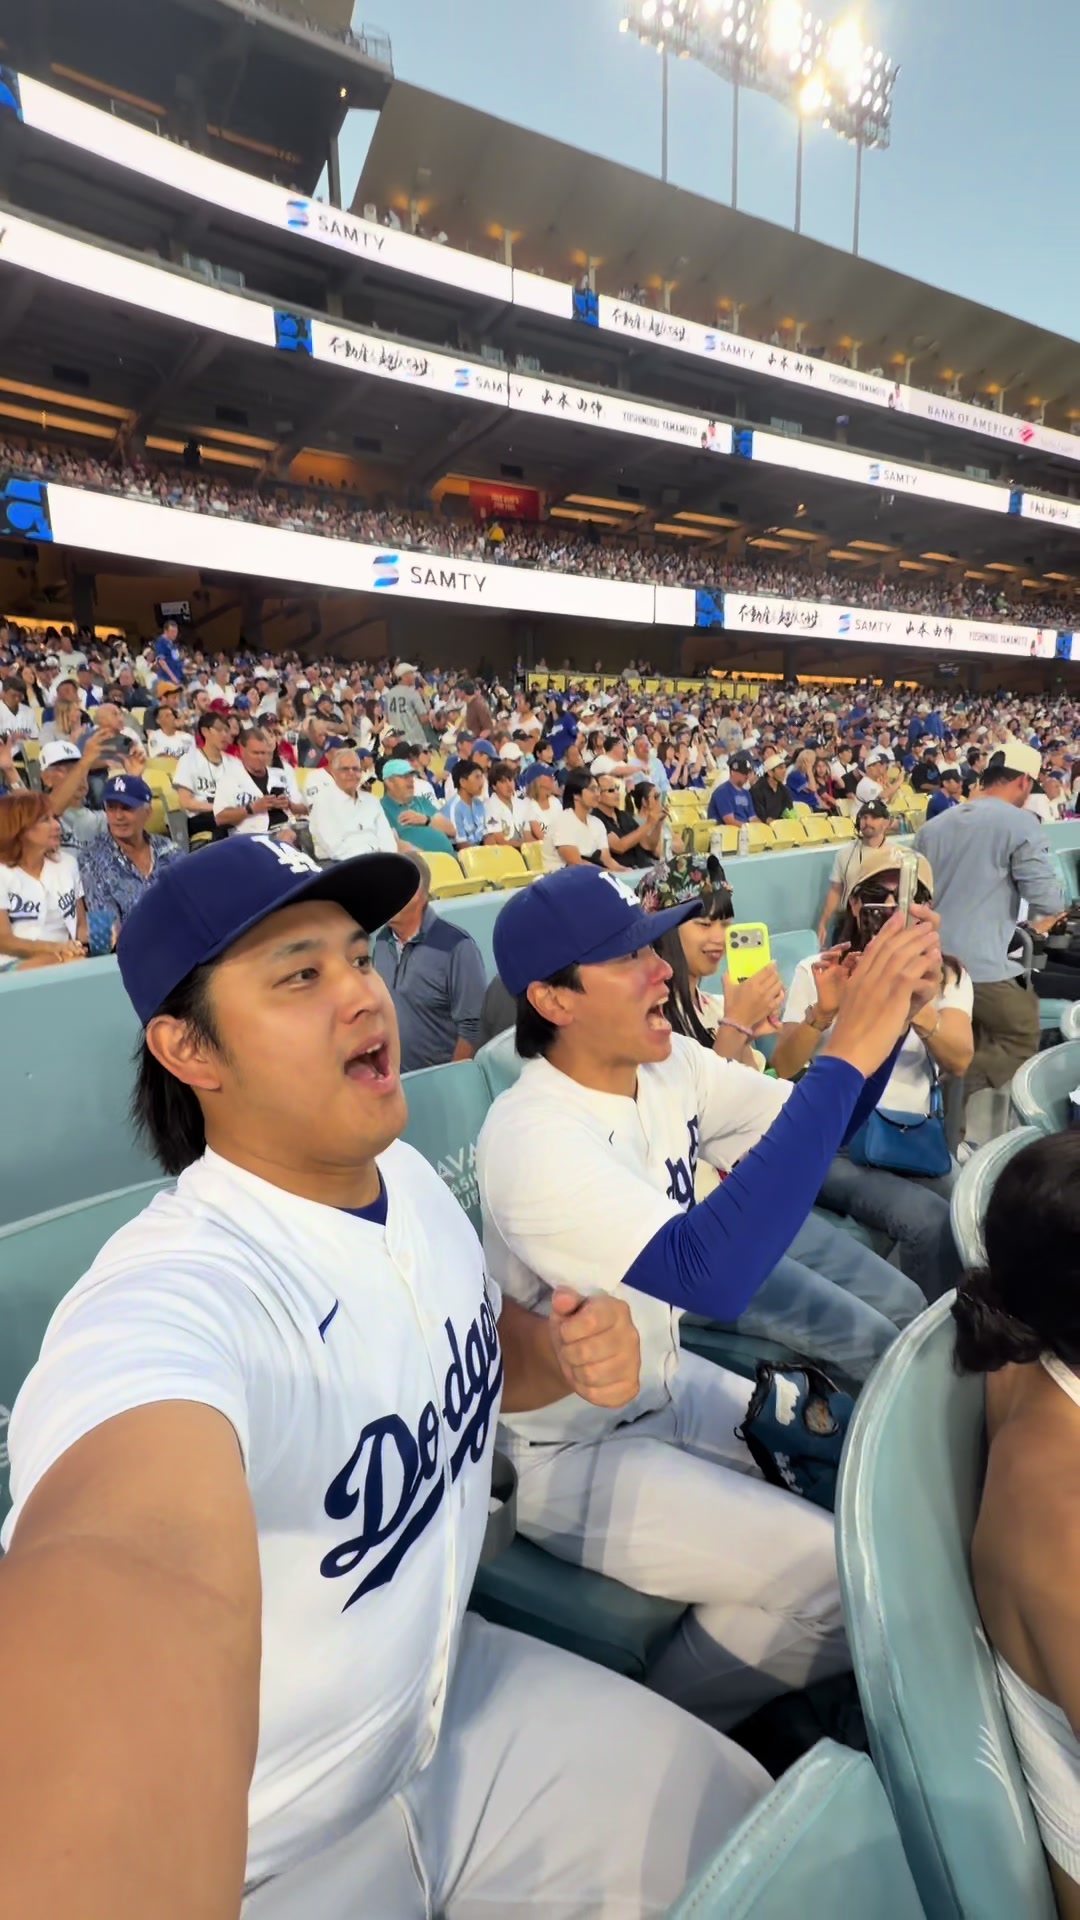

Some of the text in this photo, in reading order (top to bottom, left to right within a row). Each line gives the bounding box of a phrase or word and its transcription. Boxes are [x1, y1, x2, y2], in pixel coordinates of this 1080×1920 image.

[318, 215, 385, 250] SAMTY
[720, 341, 755, 360] SAMTY
[475, 376, 523, 397] SAMY
[927, 405, 1014, 438] BANK OF AMERICA
[883, 469, 918, 486] SAMTY
[410, 565, 487, 592] SAMTY
[854, 618, 892, 633] SAMTY
[389, 696, 407, 713] 42
